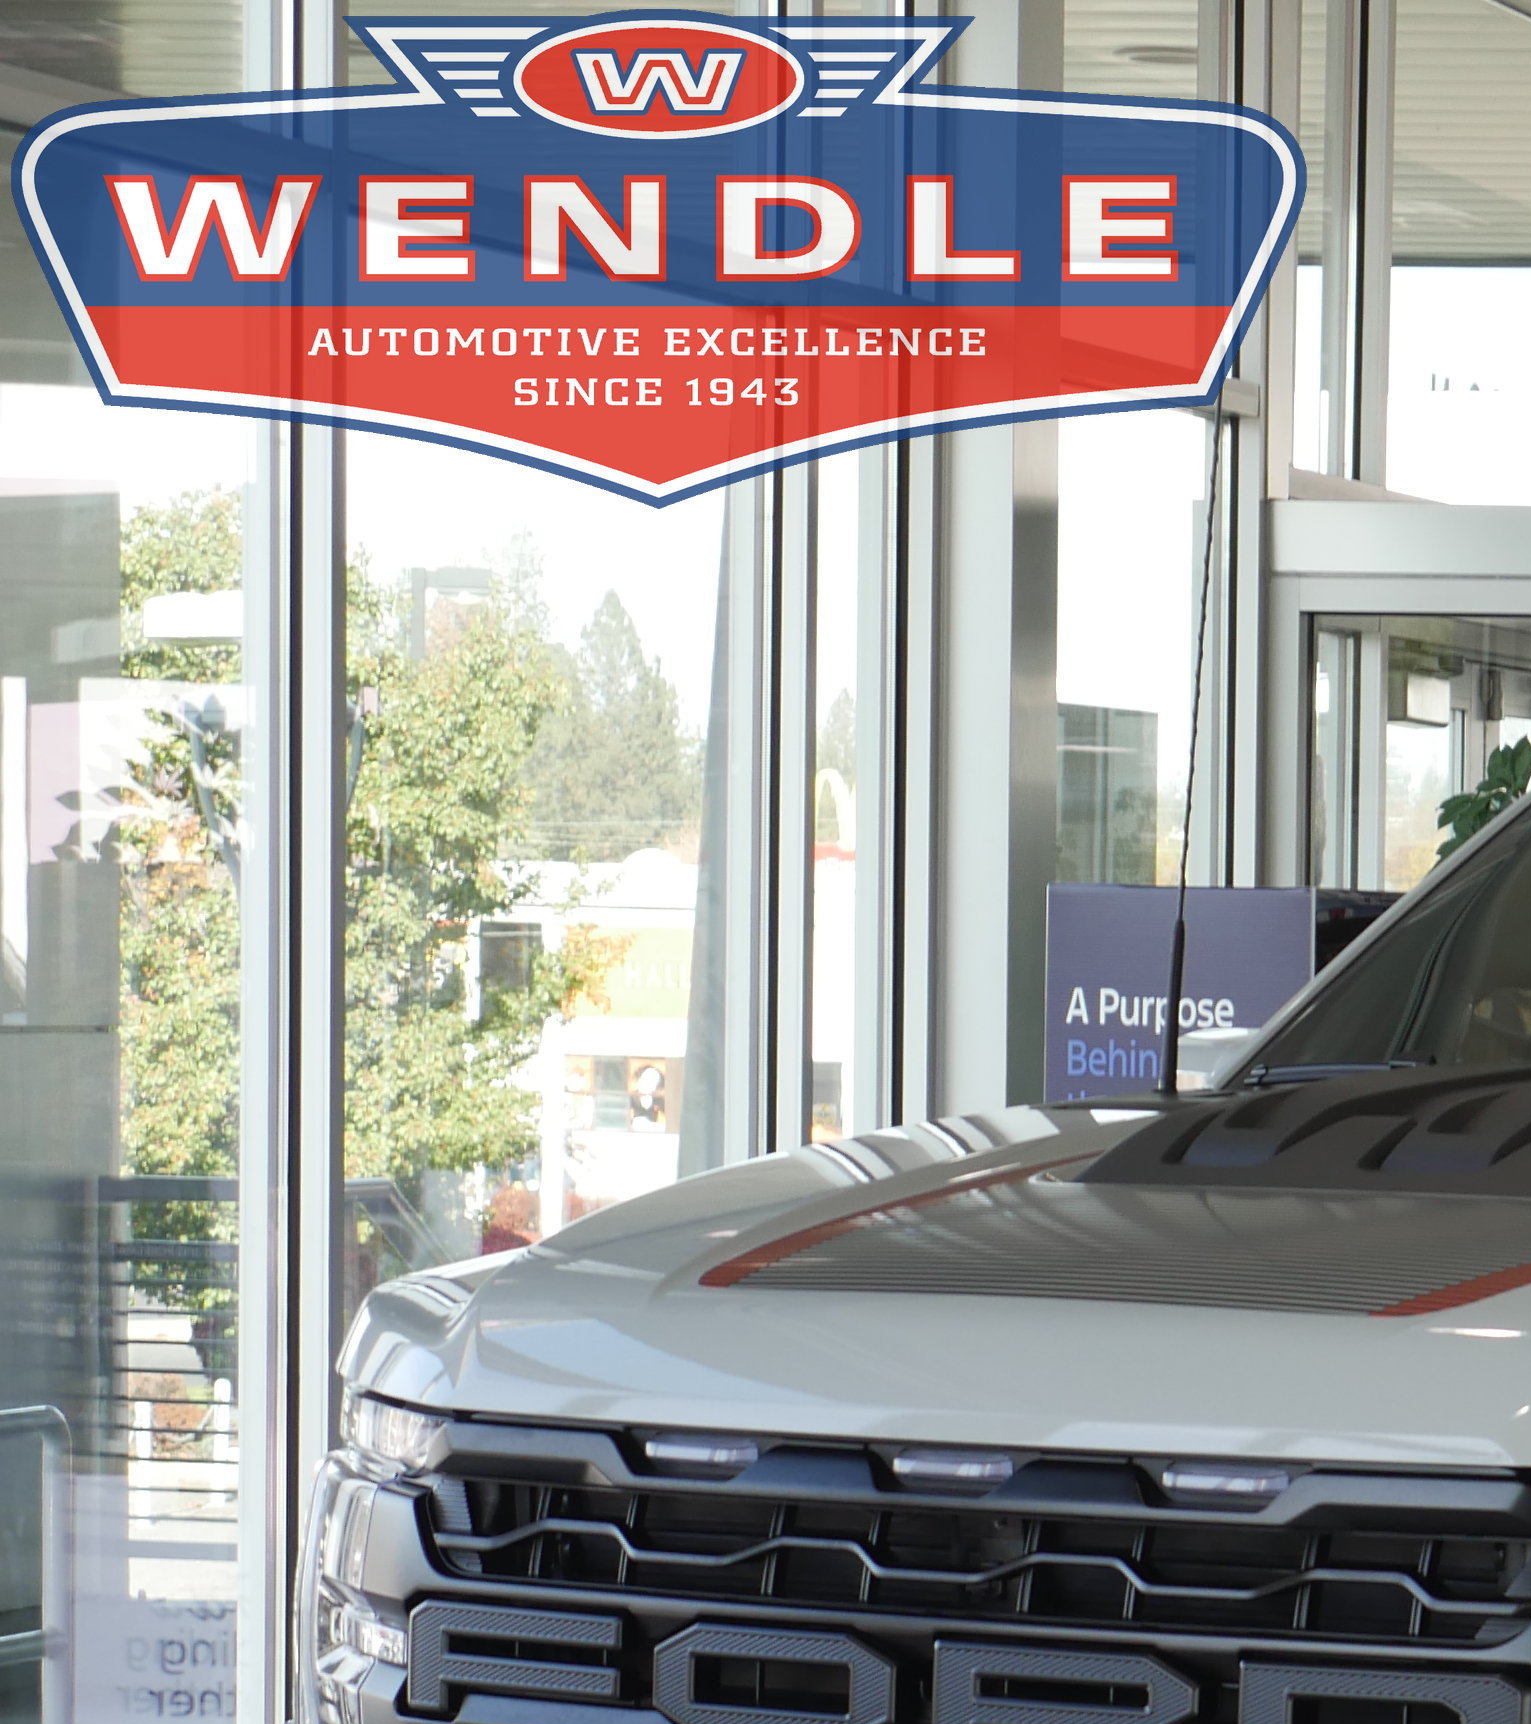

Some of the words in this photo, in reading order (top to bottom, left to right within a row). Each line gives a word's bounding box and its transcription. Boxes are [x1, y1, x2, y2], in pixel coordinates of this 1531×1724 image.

[1066, 986, 1089, 1025] A
[1099, 987, 1234, 1034] Purpose
[1067, 1040, 1162, 1079] Behin
